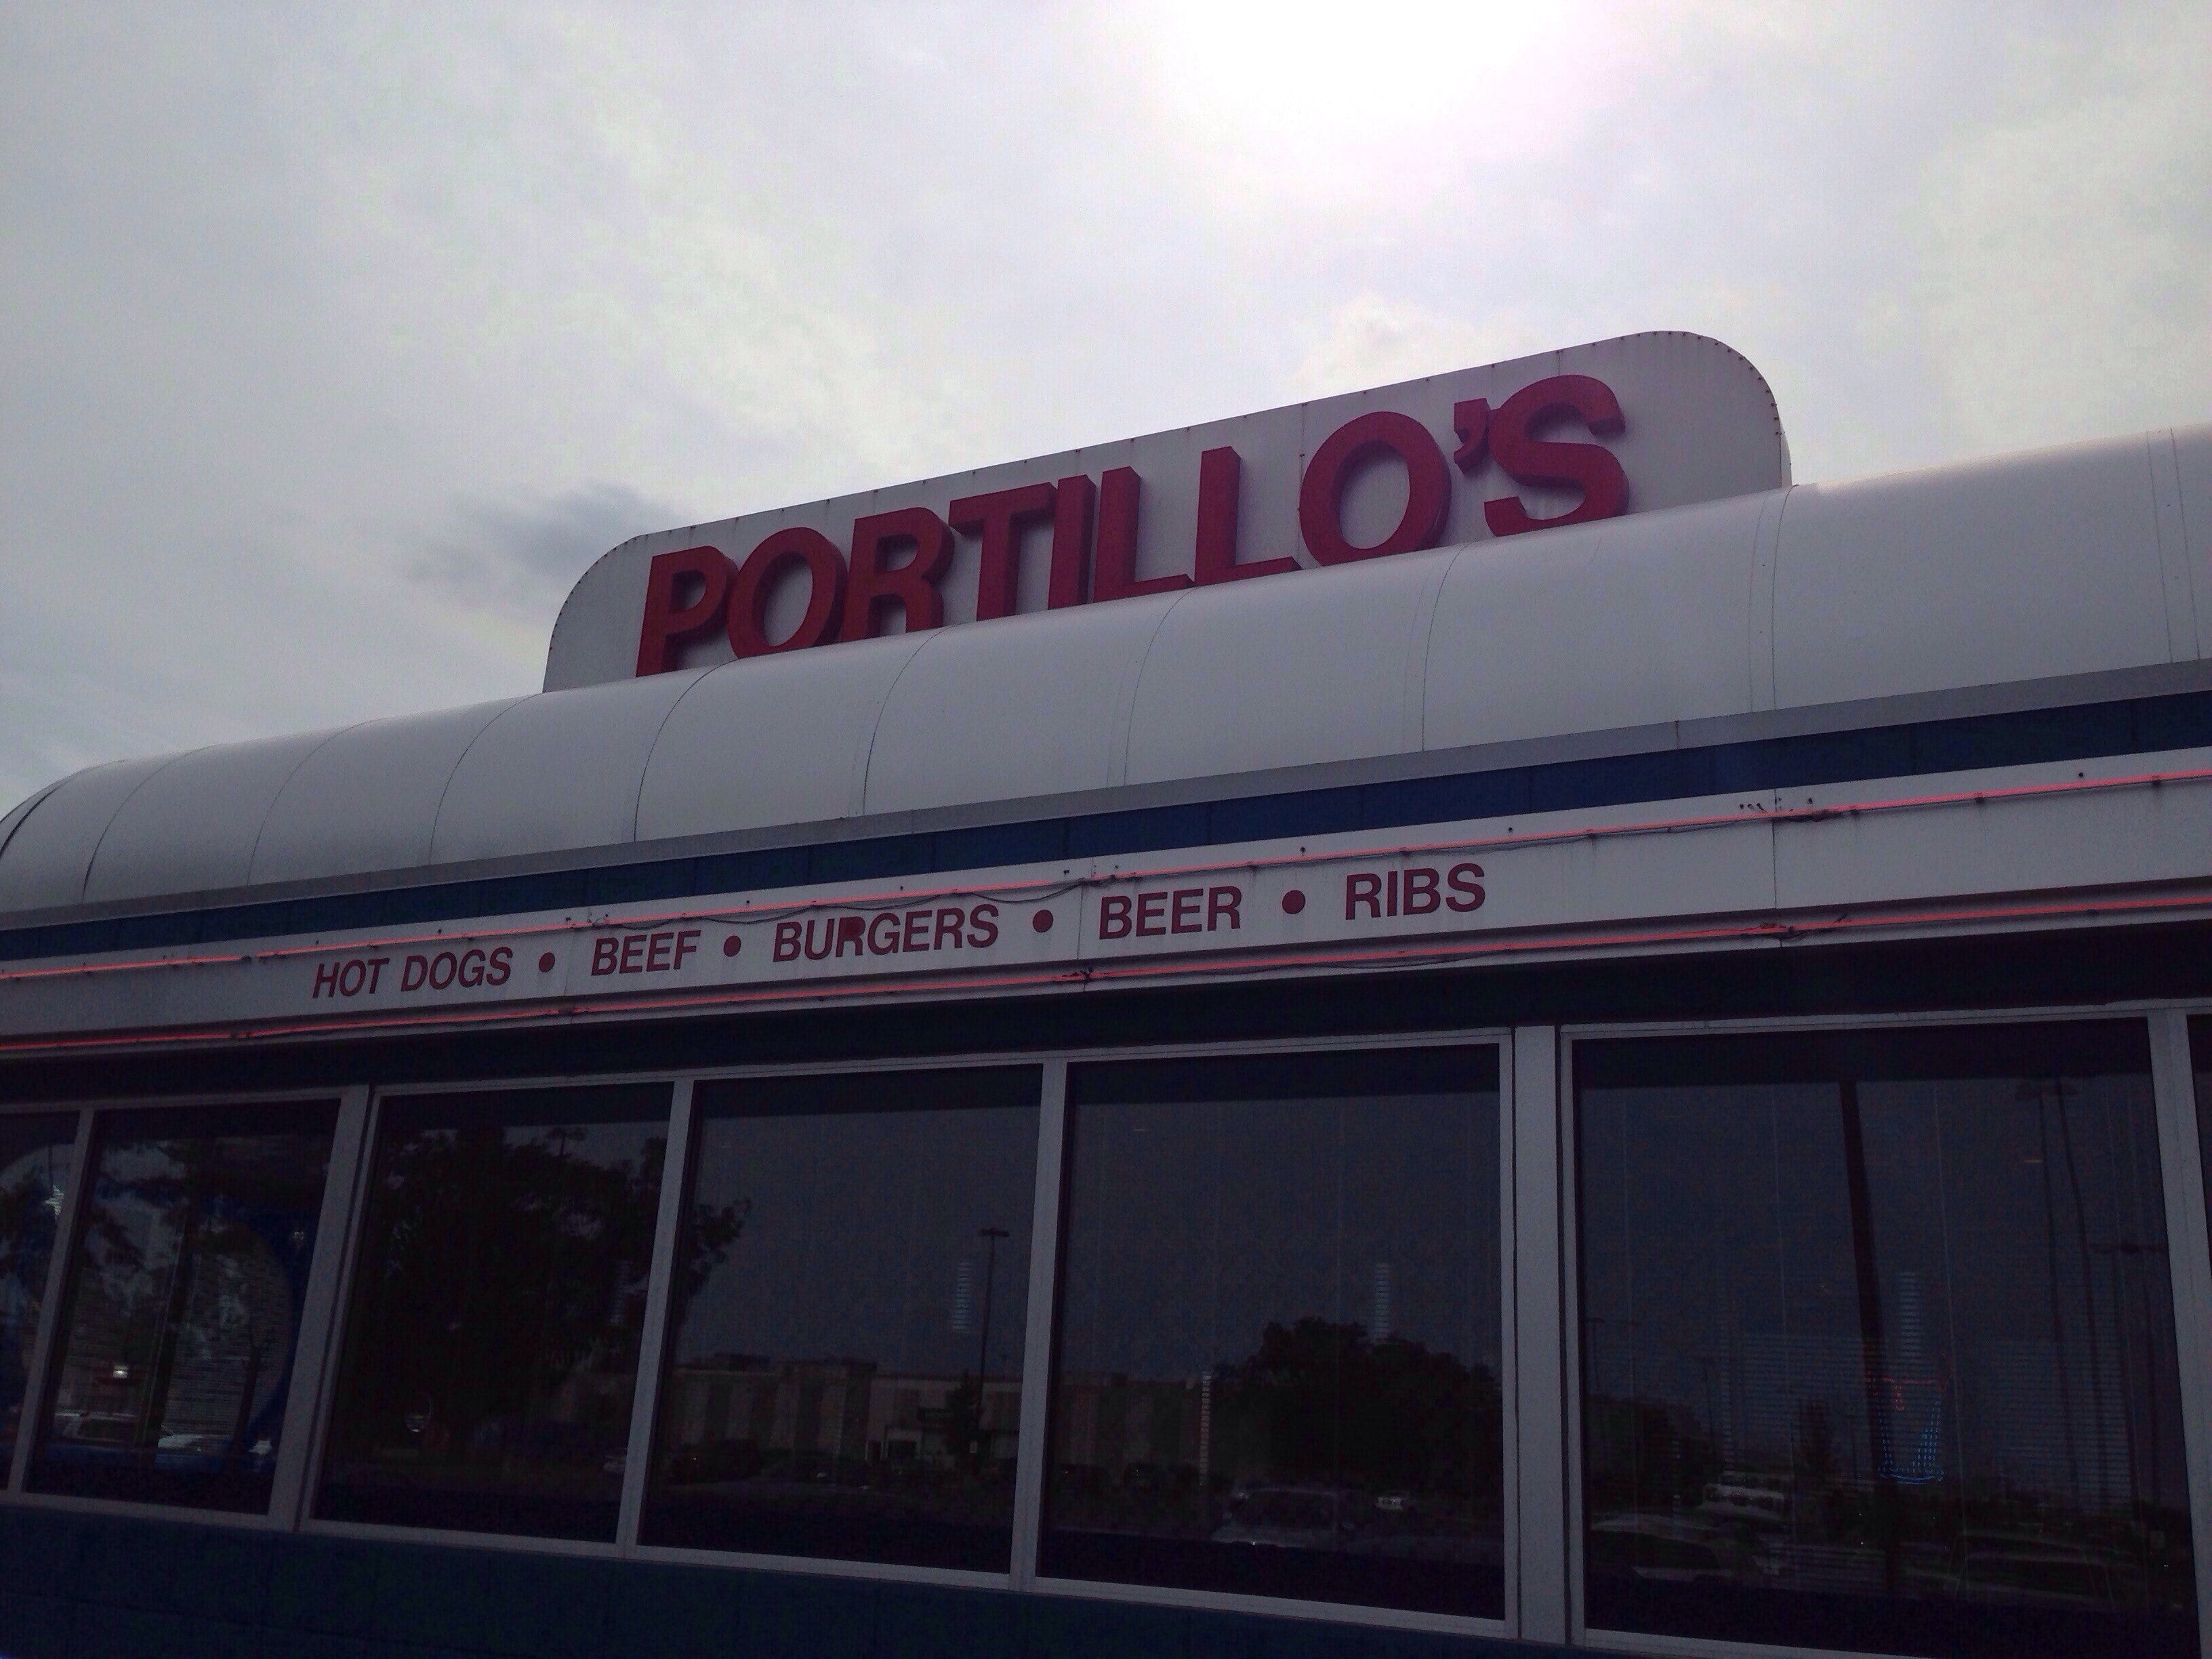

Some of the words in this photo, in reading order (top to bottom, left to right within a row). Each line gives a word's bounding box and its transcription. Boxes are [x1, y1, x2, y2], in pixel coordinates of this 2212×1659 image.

[636, 374, 1629, 678] PORTILLO'S
[312, 957, 389, 1000] HOT
[401, 946, 513, 992] DOGS
[592, 930, 702, 977] BEEF
[773, 905, 999, 962] BURGERS
[1099, 885, 1242, 940] BEER
[1345, 863, 1486, 920] RIBS
